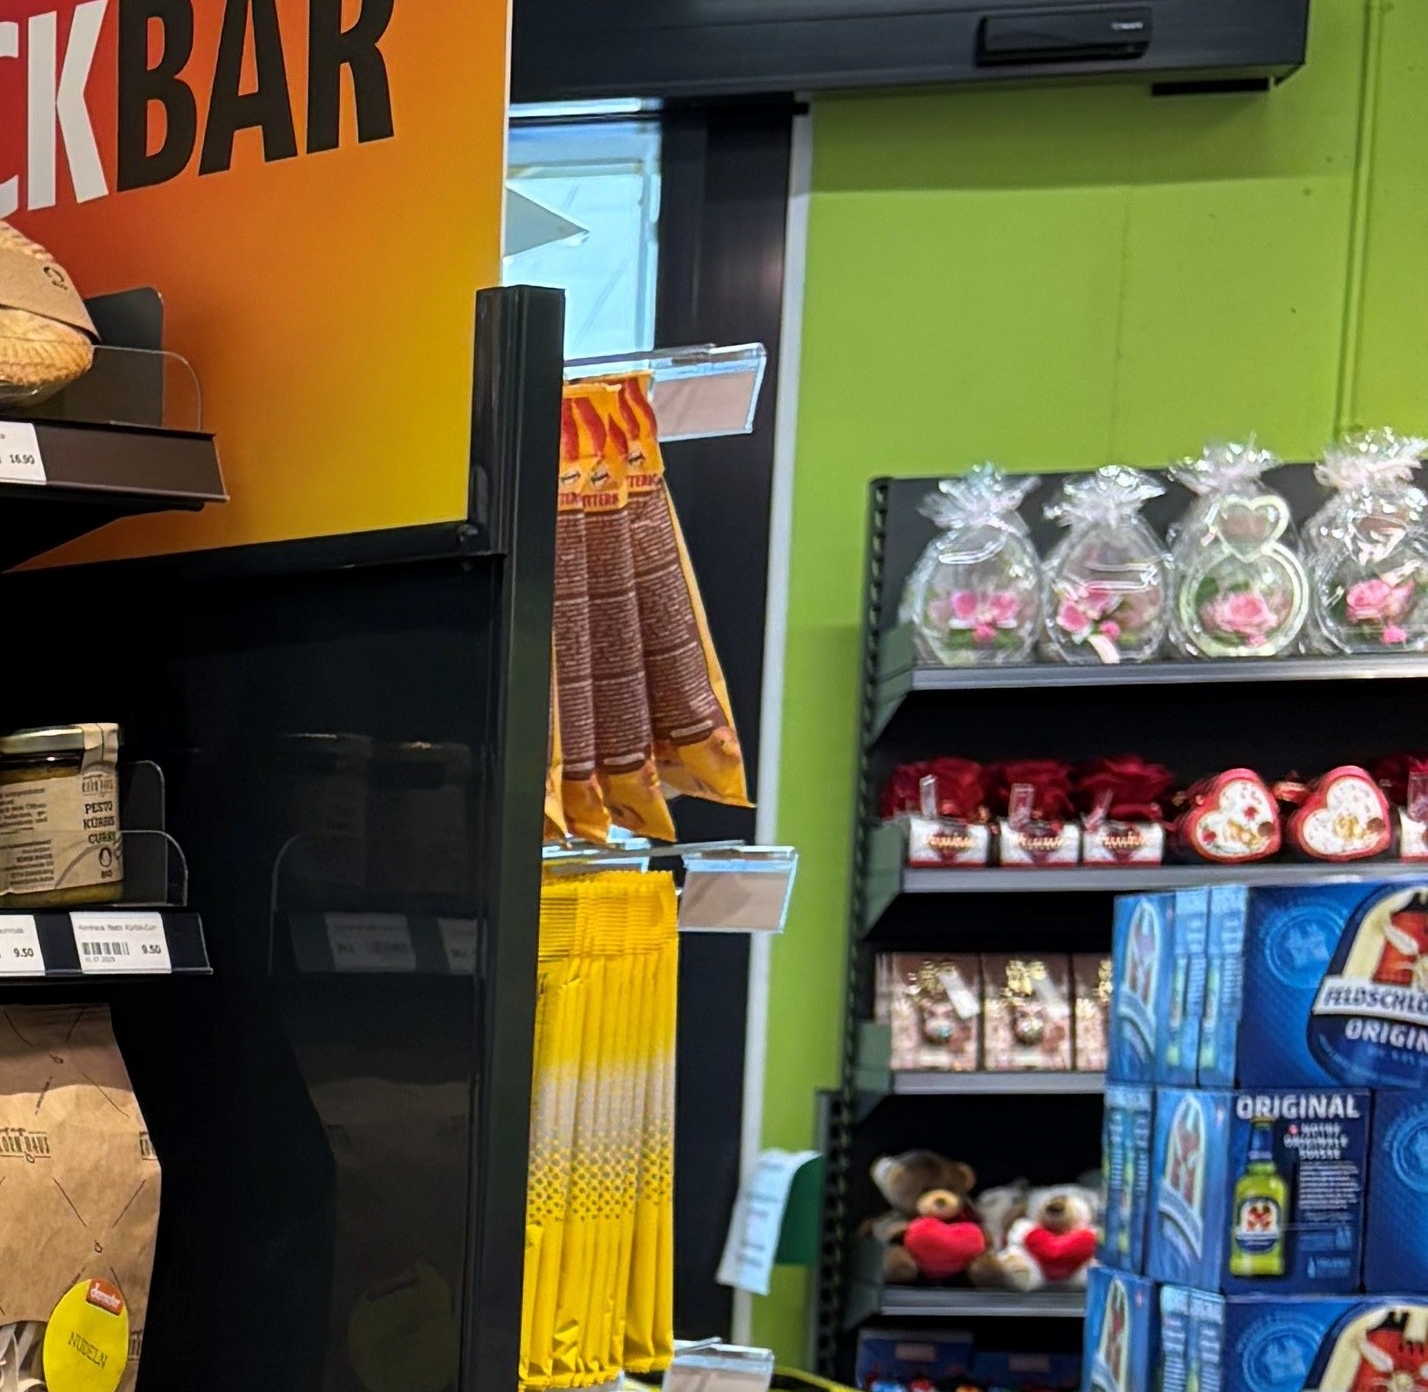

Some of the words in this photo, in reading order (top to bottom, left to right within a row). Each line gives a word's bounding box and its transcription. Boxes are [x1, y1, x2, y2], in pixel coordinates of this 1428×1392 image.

[85, 802, 113, 814] PESTO
[13, 948, 34, 958] 9.50
[142, 945, 161, 954] 9.50
[1236, 1094, 1360, 1120] ORIGINAL
[67, 1331, 109, 1369] NUDELN
